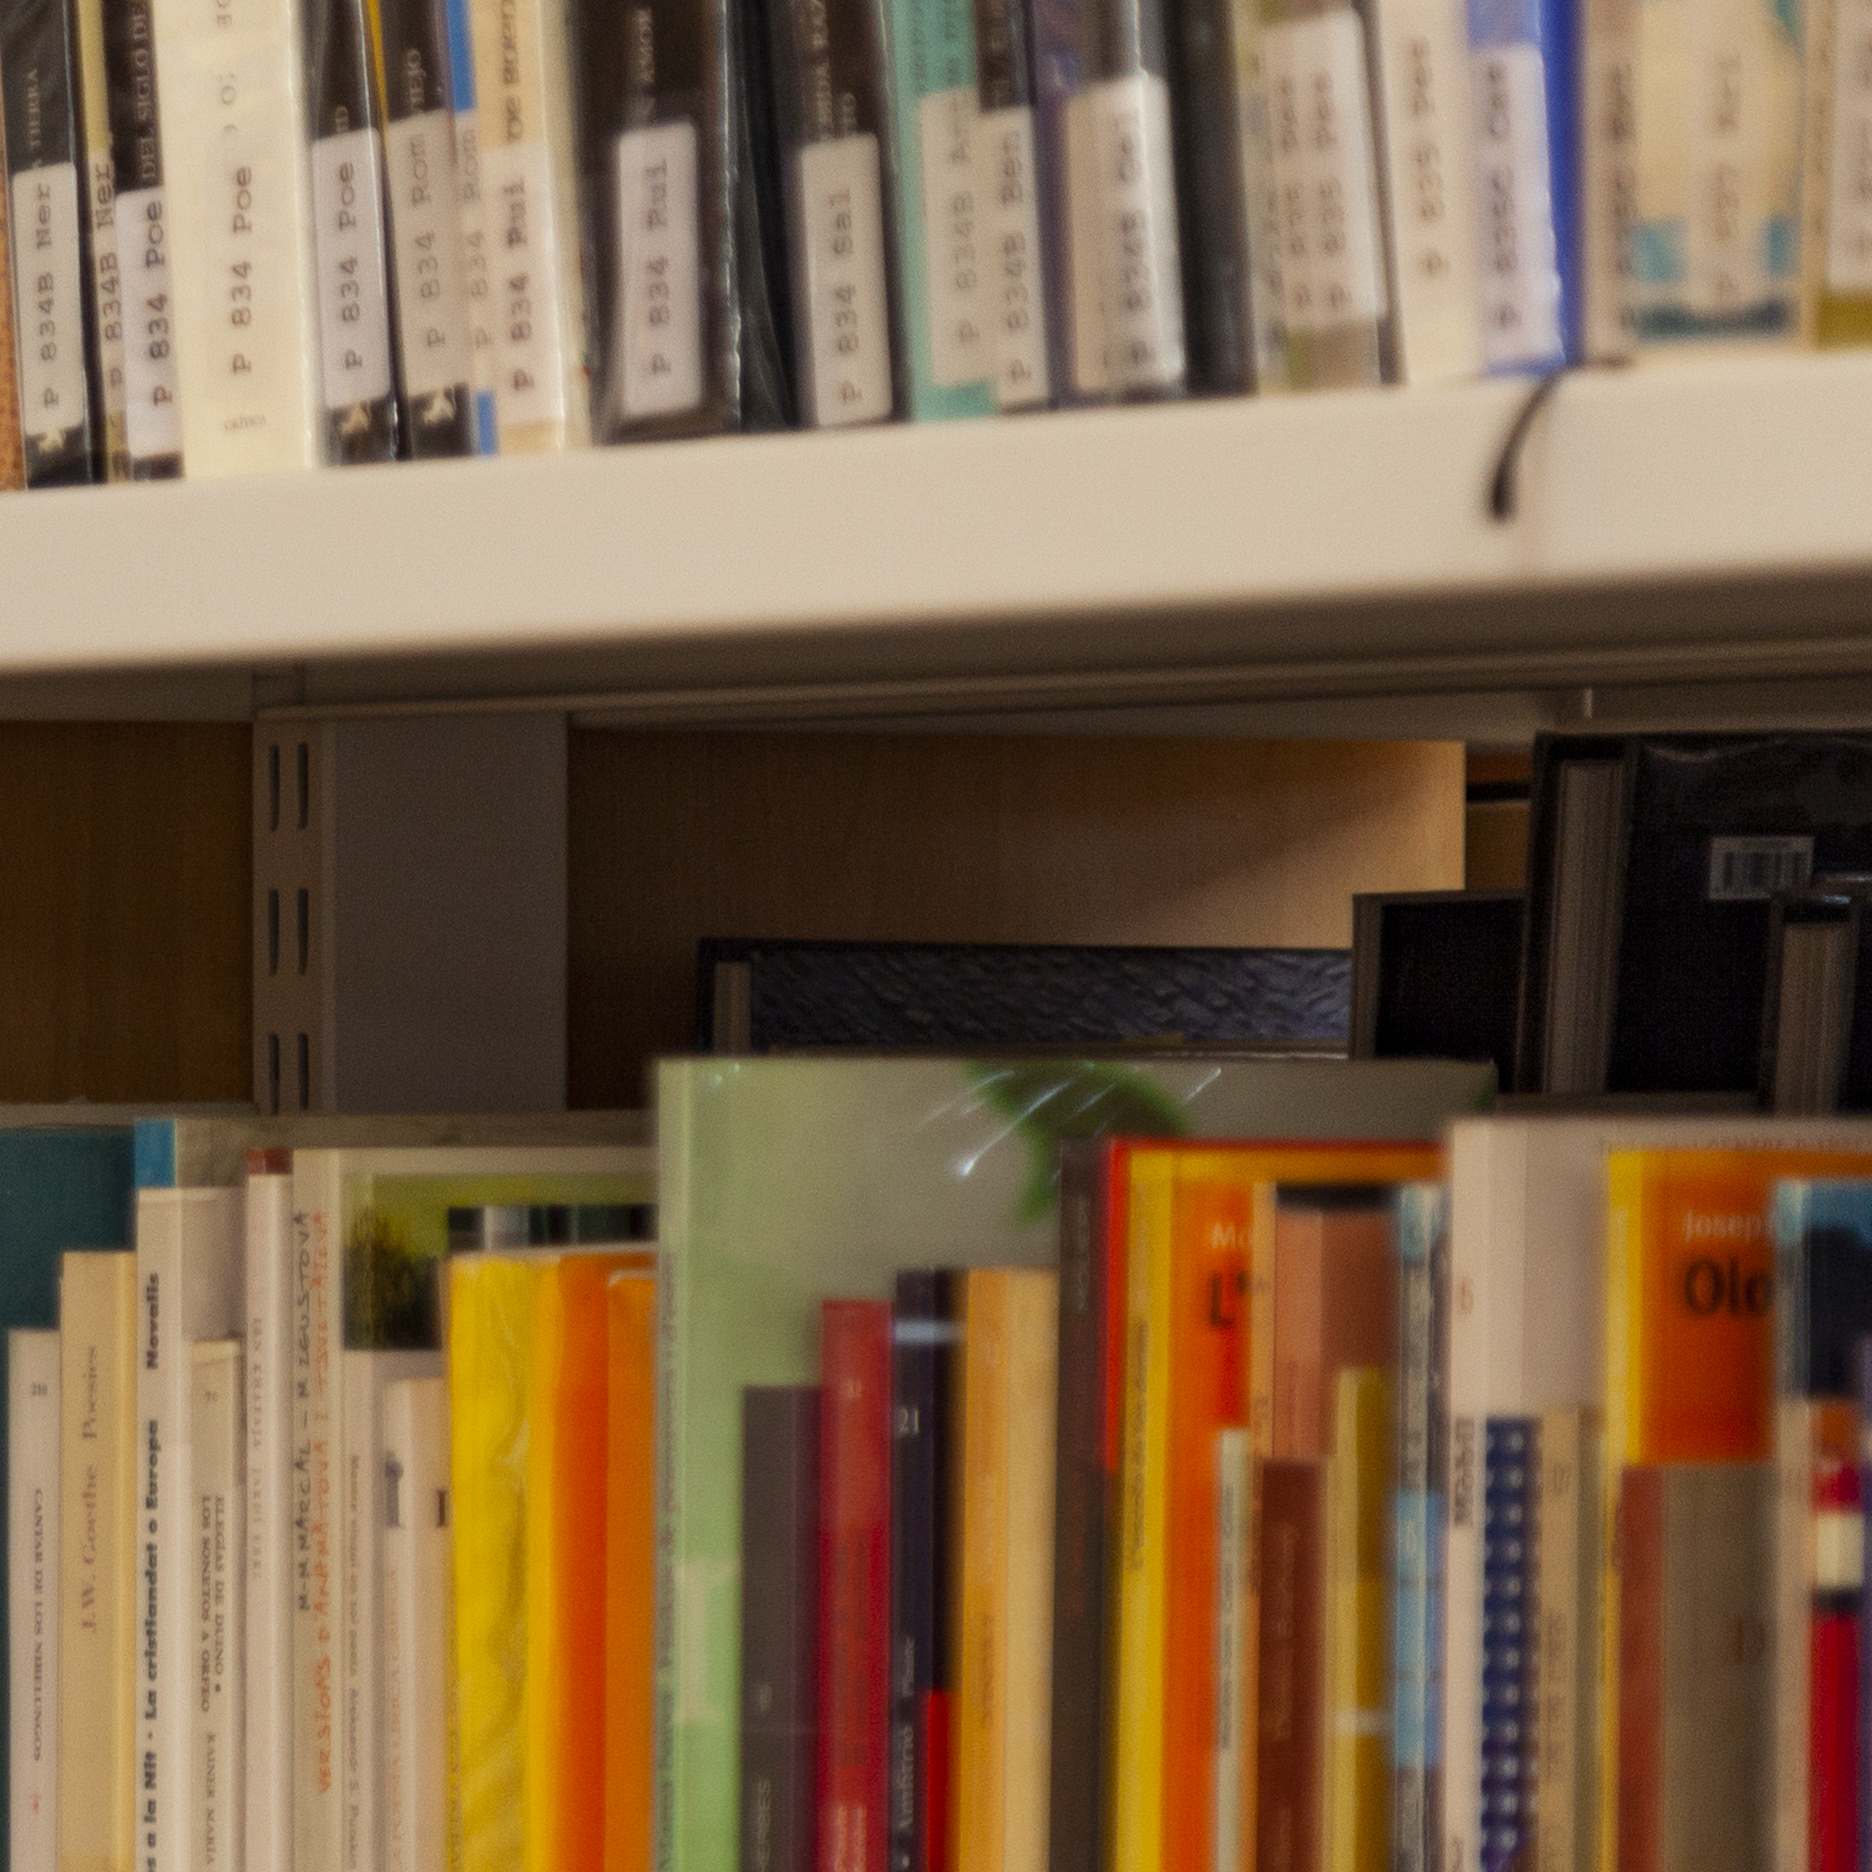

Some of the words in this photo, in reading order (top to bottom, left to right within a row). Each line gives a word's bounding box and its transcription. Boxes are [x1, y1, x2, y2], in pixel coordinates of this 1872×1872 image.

[232, 167, 252, 233] Poe
[232, 262, 251, 327] 834
[232, 353, 251, 374] P
